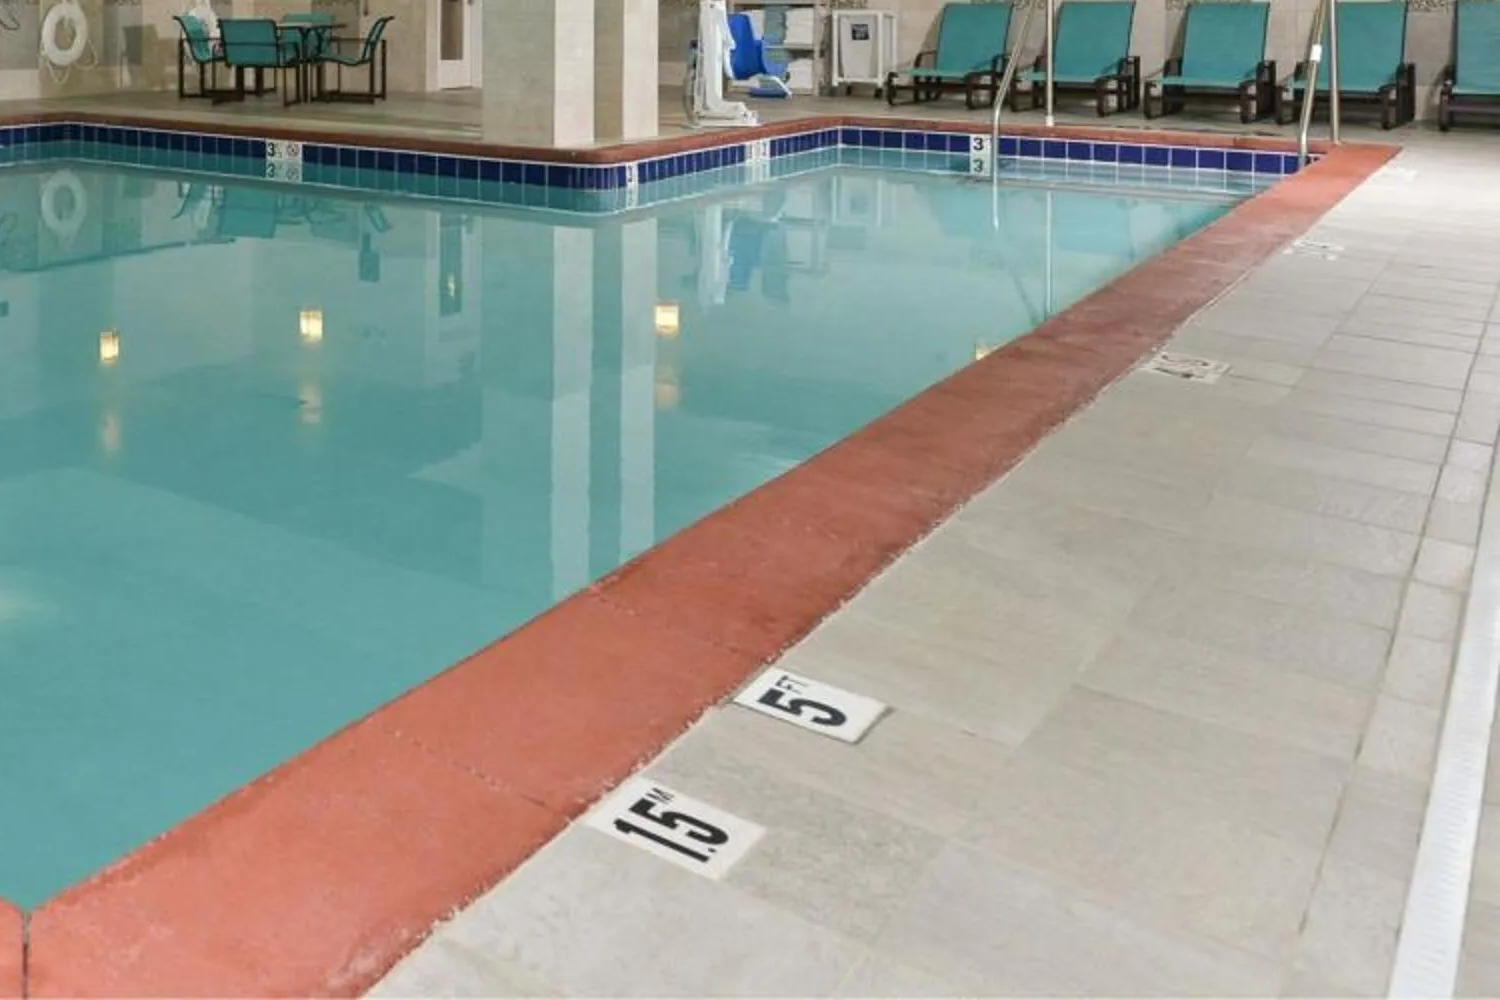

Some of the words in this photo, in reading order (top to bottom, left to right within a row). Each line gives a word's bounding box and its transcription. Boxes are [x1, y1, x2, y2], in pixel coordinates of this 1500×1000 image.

[267, 142, 275, 157] 3
[973, 137, 985, 151] 3
[756, 687, 848, 727] 5
